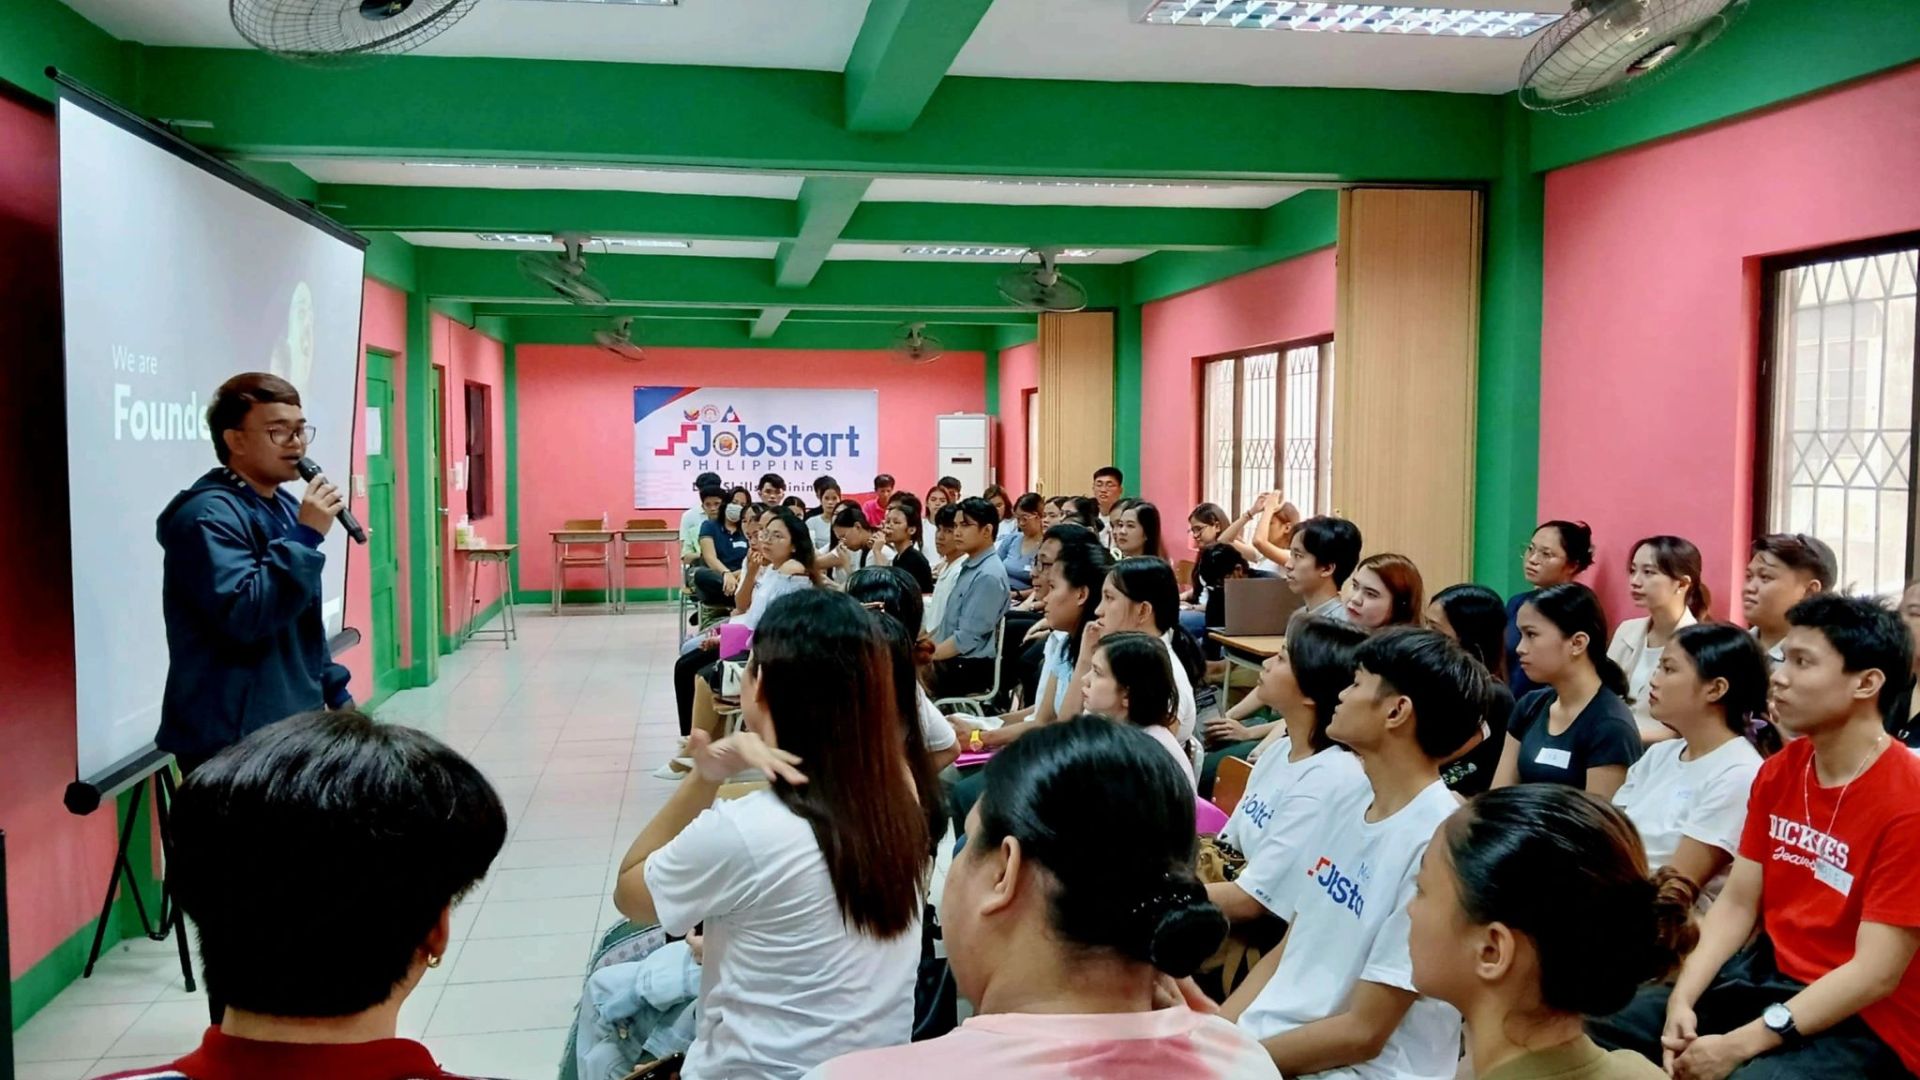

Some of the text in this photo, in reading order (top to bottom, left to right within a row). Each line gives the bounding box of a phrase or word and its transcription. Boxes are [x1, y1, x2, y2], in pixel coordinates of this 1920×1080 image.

[112, 344, 158, 375] We are
[114, 383, 211, 441] Founde
[690, 424, 860, 458] JobStart
[682, 459, 834, 472] PHILIPPINES
